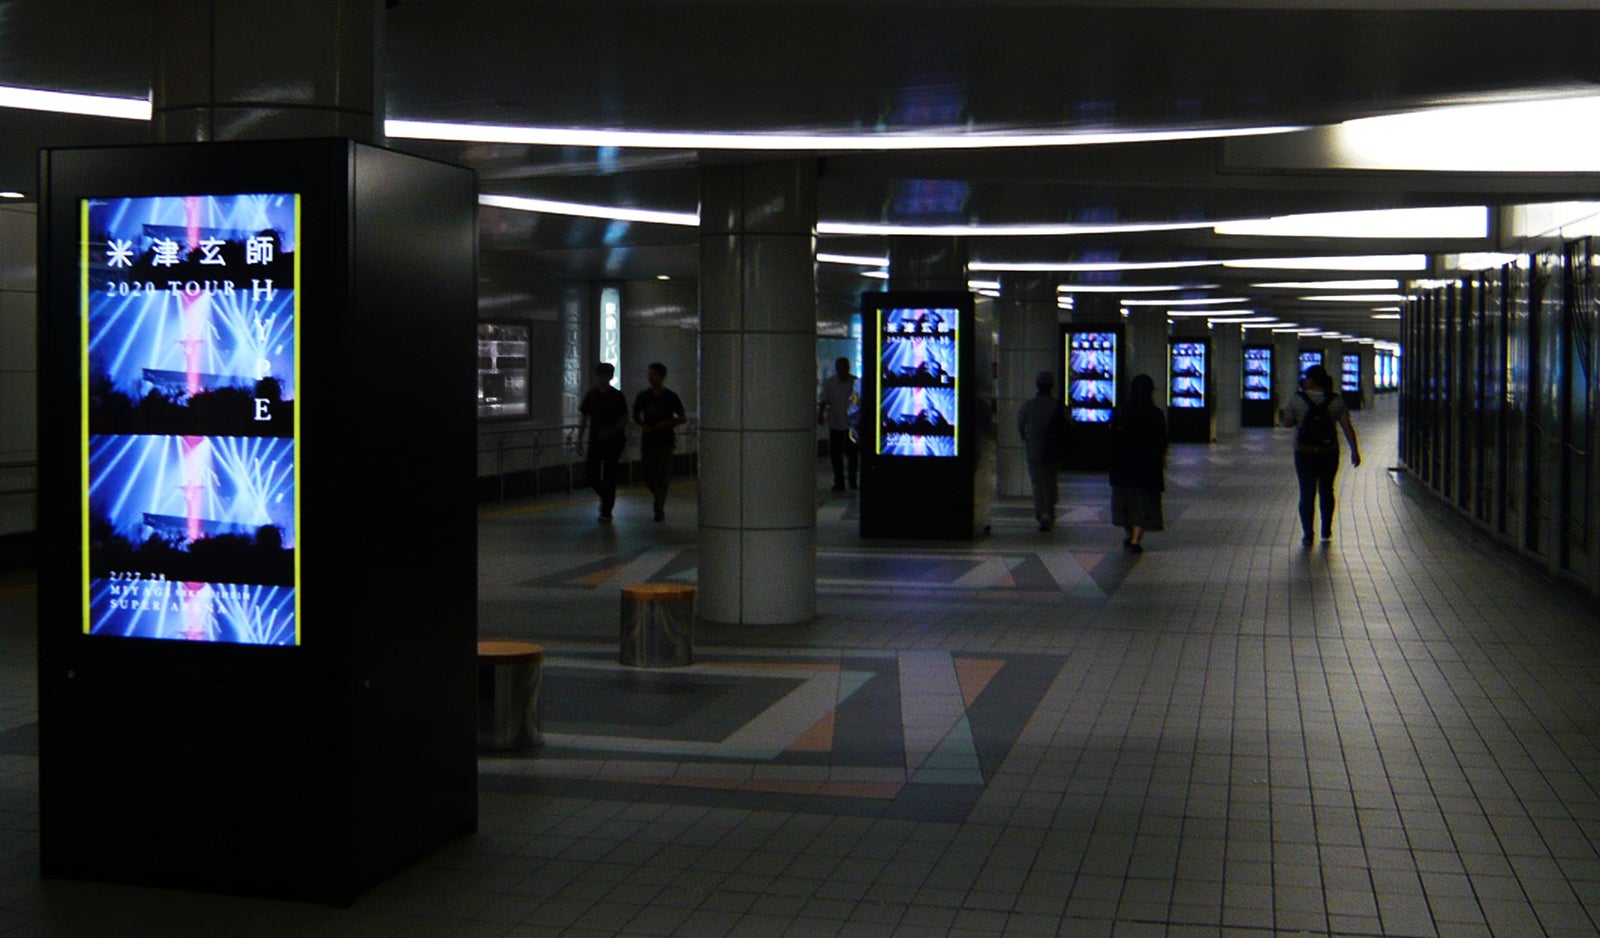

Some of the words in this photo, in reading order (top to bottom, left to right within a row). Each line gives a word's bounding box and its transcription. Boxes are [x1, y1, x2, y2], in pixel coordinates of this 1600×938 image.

[106, 235, 274, 268] 米津玄師
[106, 280, 156, 297] 2020
[168, 280, 236, 297] TOUR
[109, 599, 161, 611] SUPER
